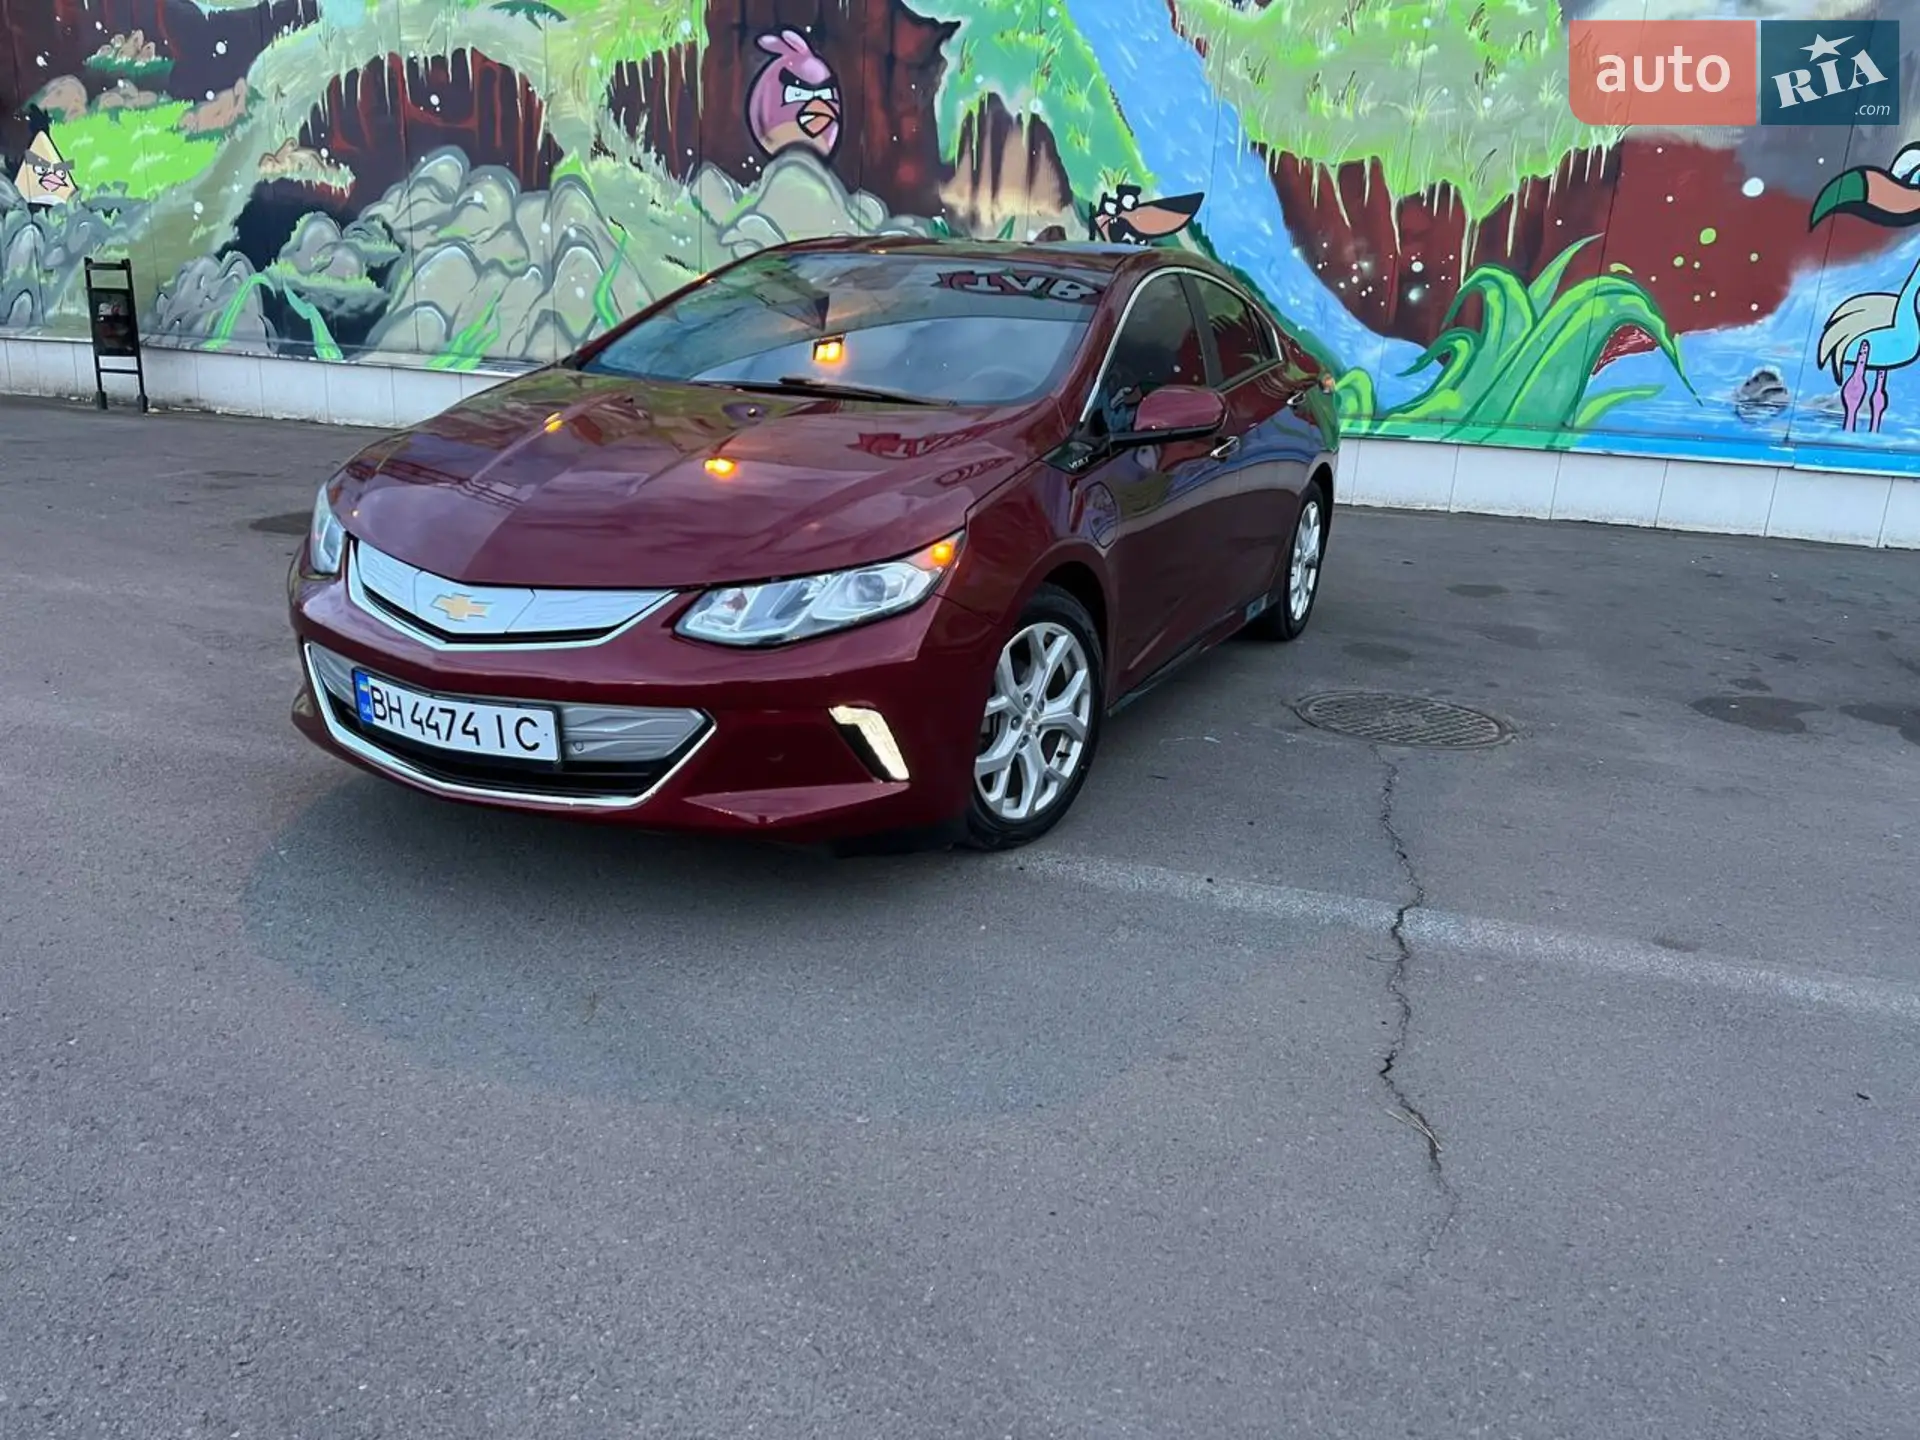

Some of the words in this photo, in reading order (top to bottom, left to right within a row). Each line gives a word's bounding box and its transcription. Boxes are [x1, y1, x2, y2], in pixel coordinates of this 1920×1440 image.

[370, 685, 405, 729] BH
[410, 702, 481, 746] 4474
[496, 714, 541, 751] IC
